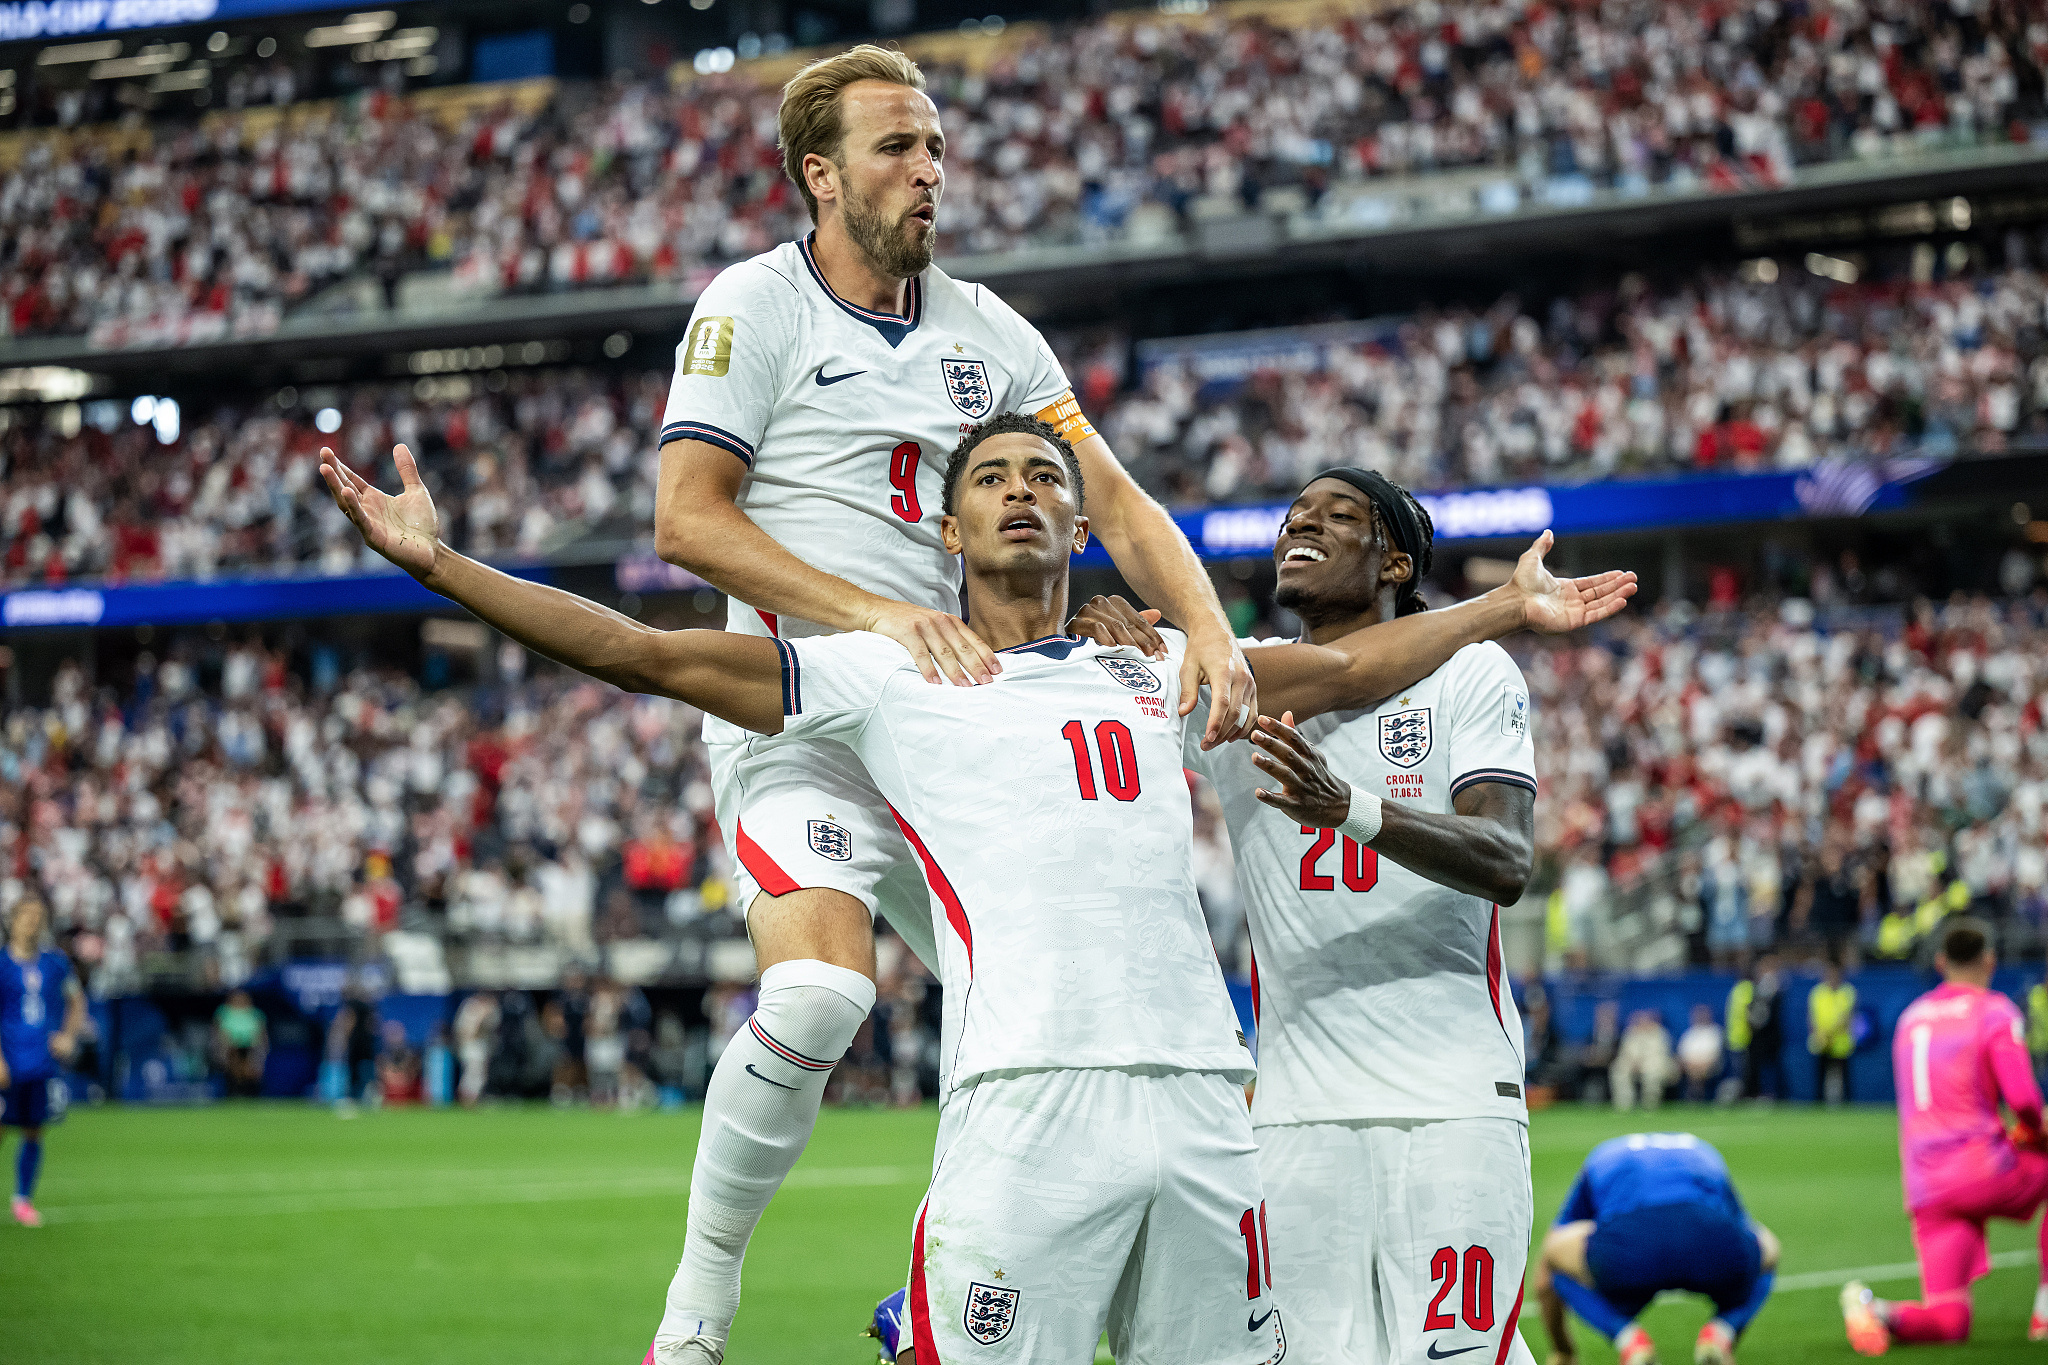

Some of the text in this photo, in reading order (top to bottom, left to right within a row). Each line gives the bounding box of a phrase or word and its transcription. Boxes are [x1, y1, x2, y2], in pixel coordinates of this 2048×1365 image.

[690, 363, 715, 371] 2026
[889, 441, 923, 523] 9
[1061, 719, 1142, 802] 10
[1385, 774, 1424, 786] CROATIA
[1390, 787, 1423, 799] 17.06.26
[1299, 824, 1379, 893] 20
[1423, 1244, 1496, 1333] 20
